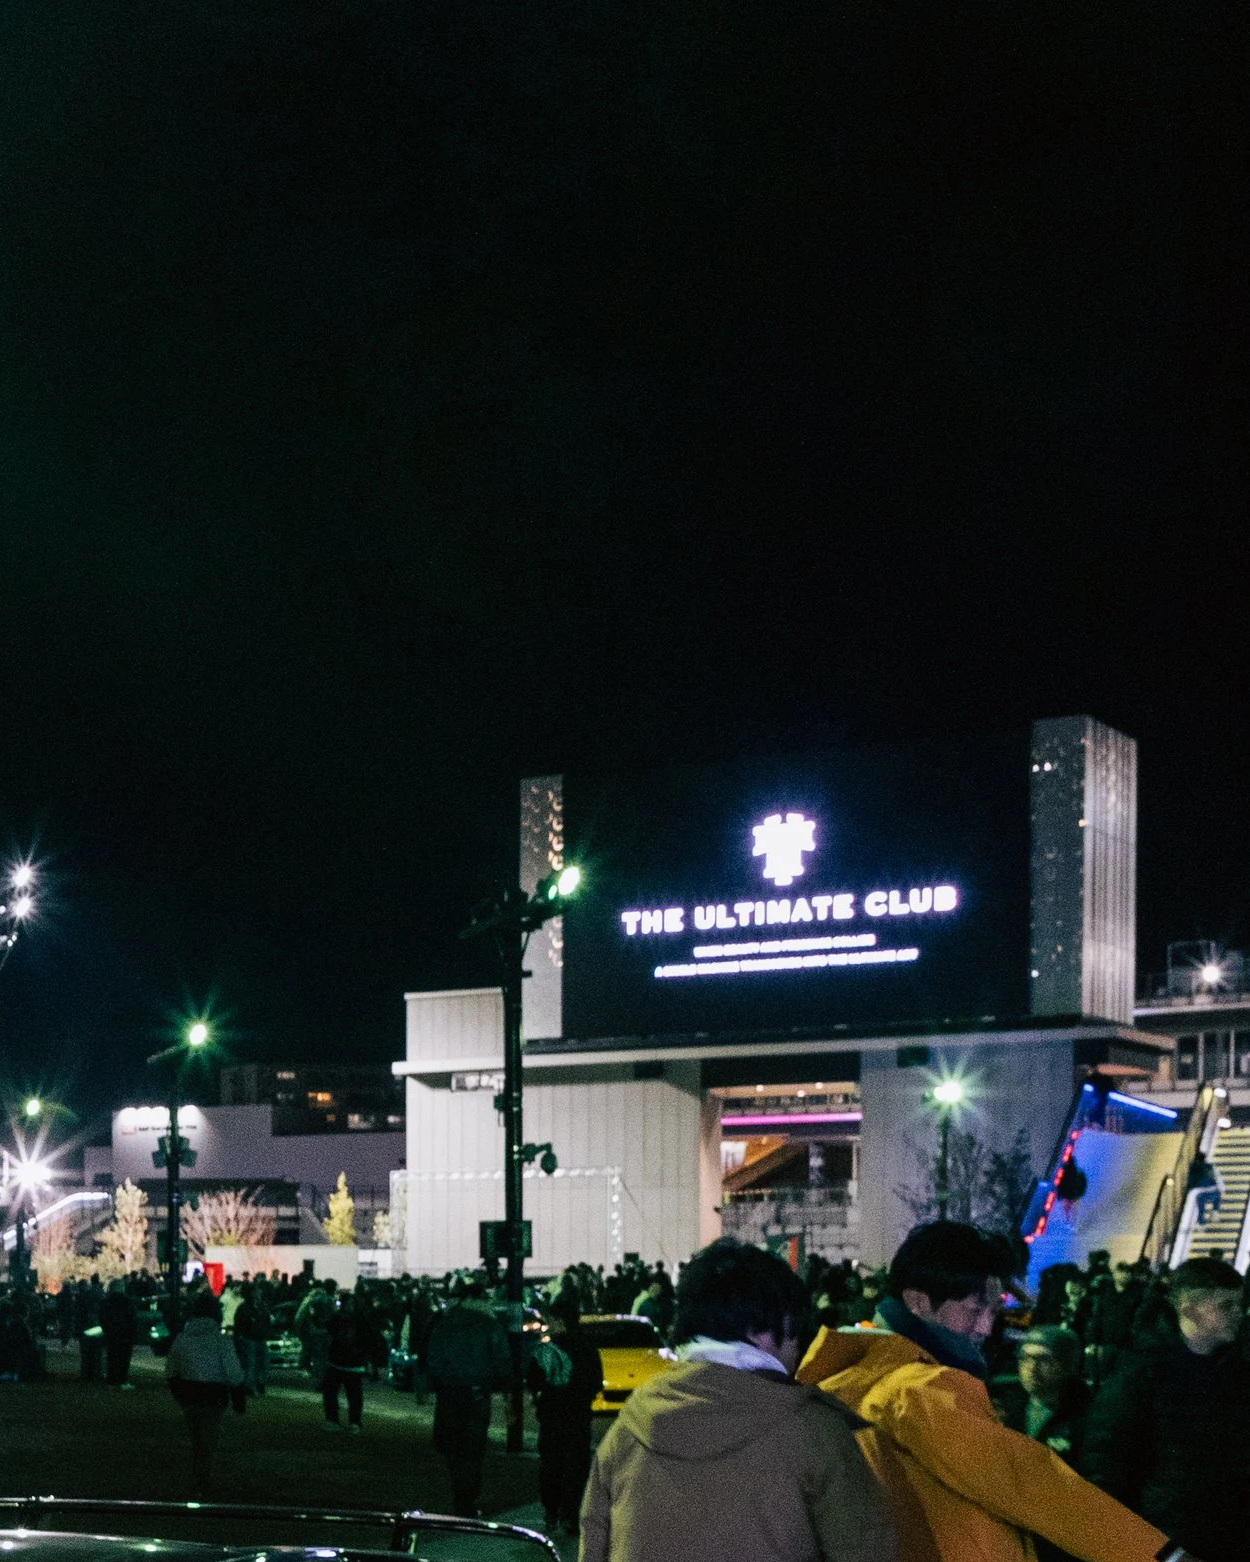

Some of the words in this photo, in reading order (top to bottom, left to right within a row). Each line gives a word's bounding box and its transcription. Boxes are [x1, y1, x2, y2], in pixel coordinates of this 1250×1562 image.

[621, 908, 684, 935] THE
[694, 894, 855, 930] ULTIMATE
[864, 885, 958, 917] CLUB
